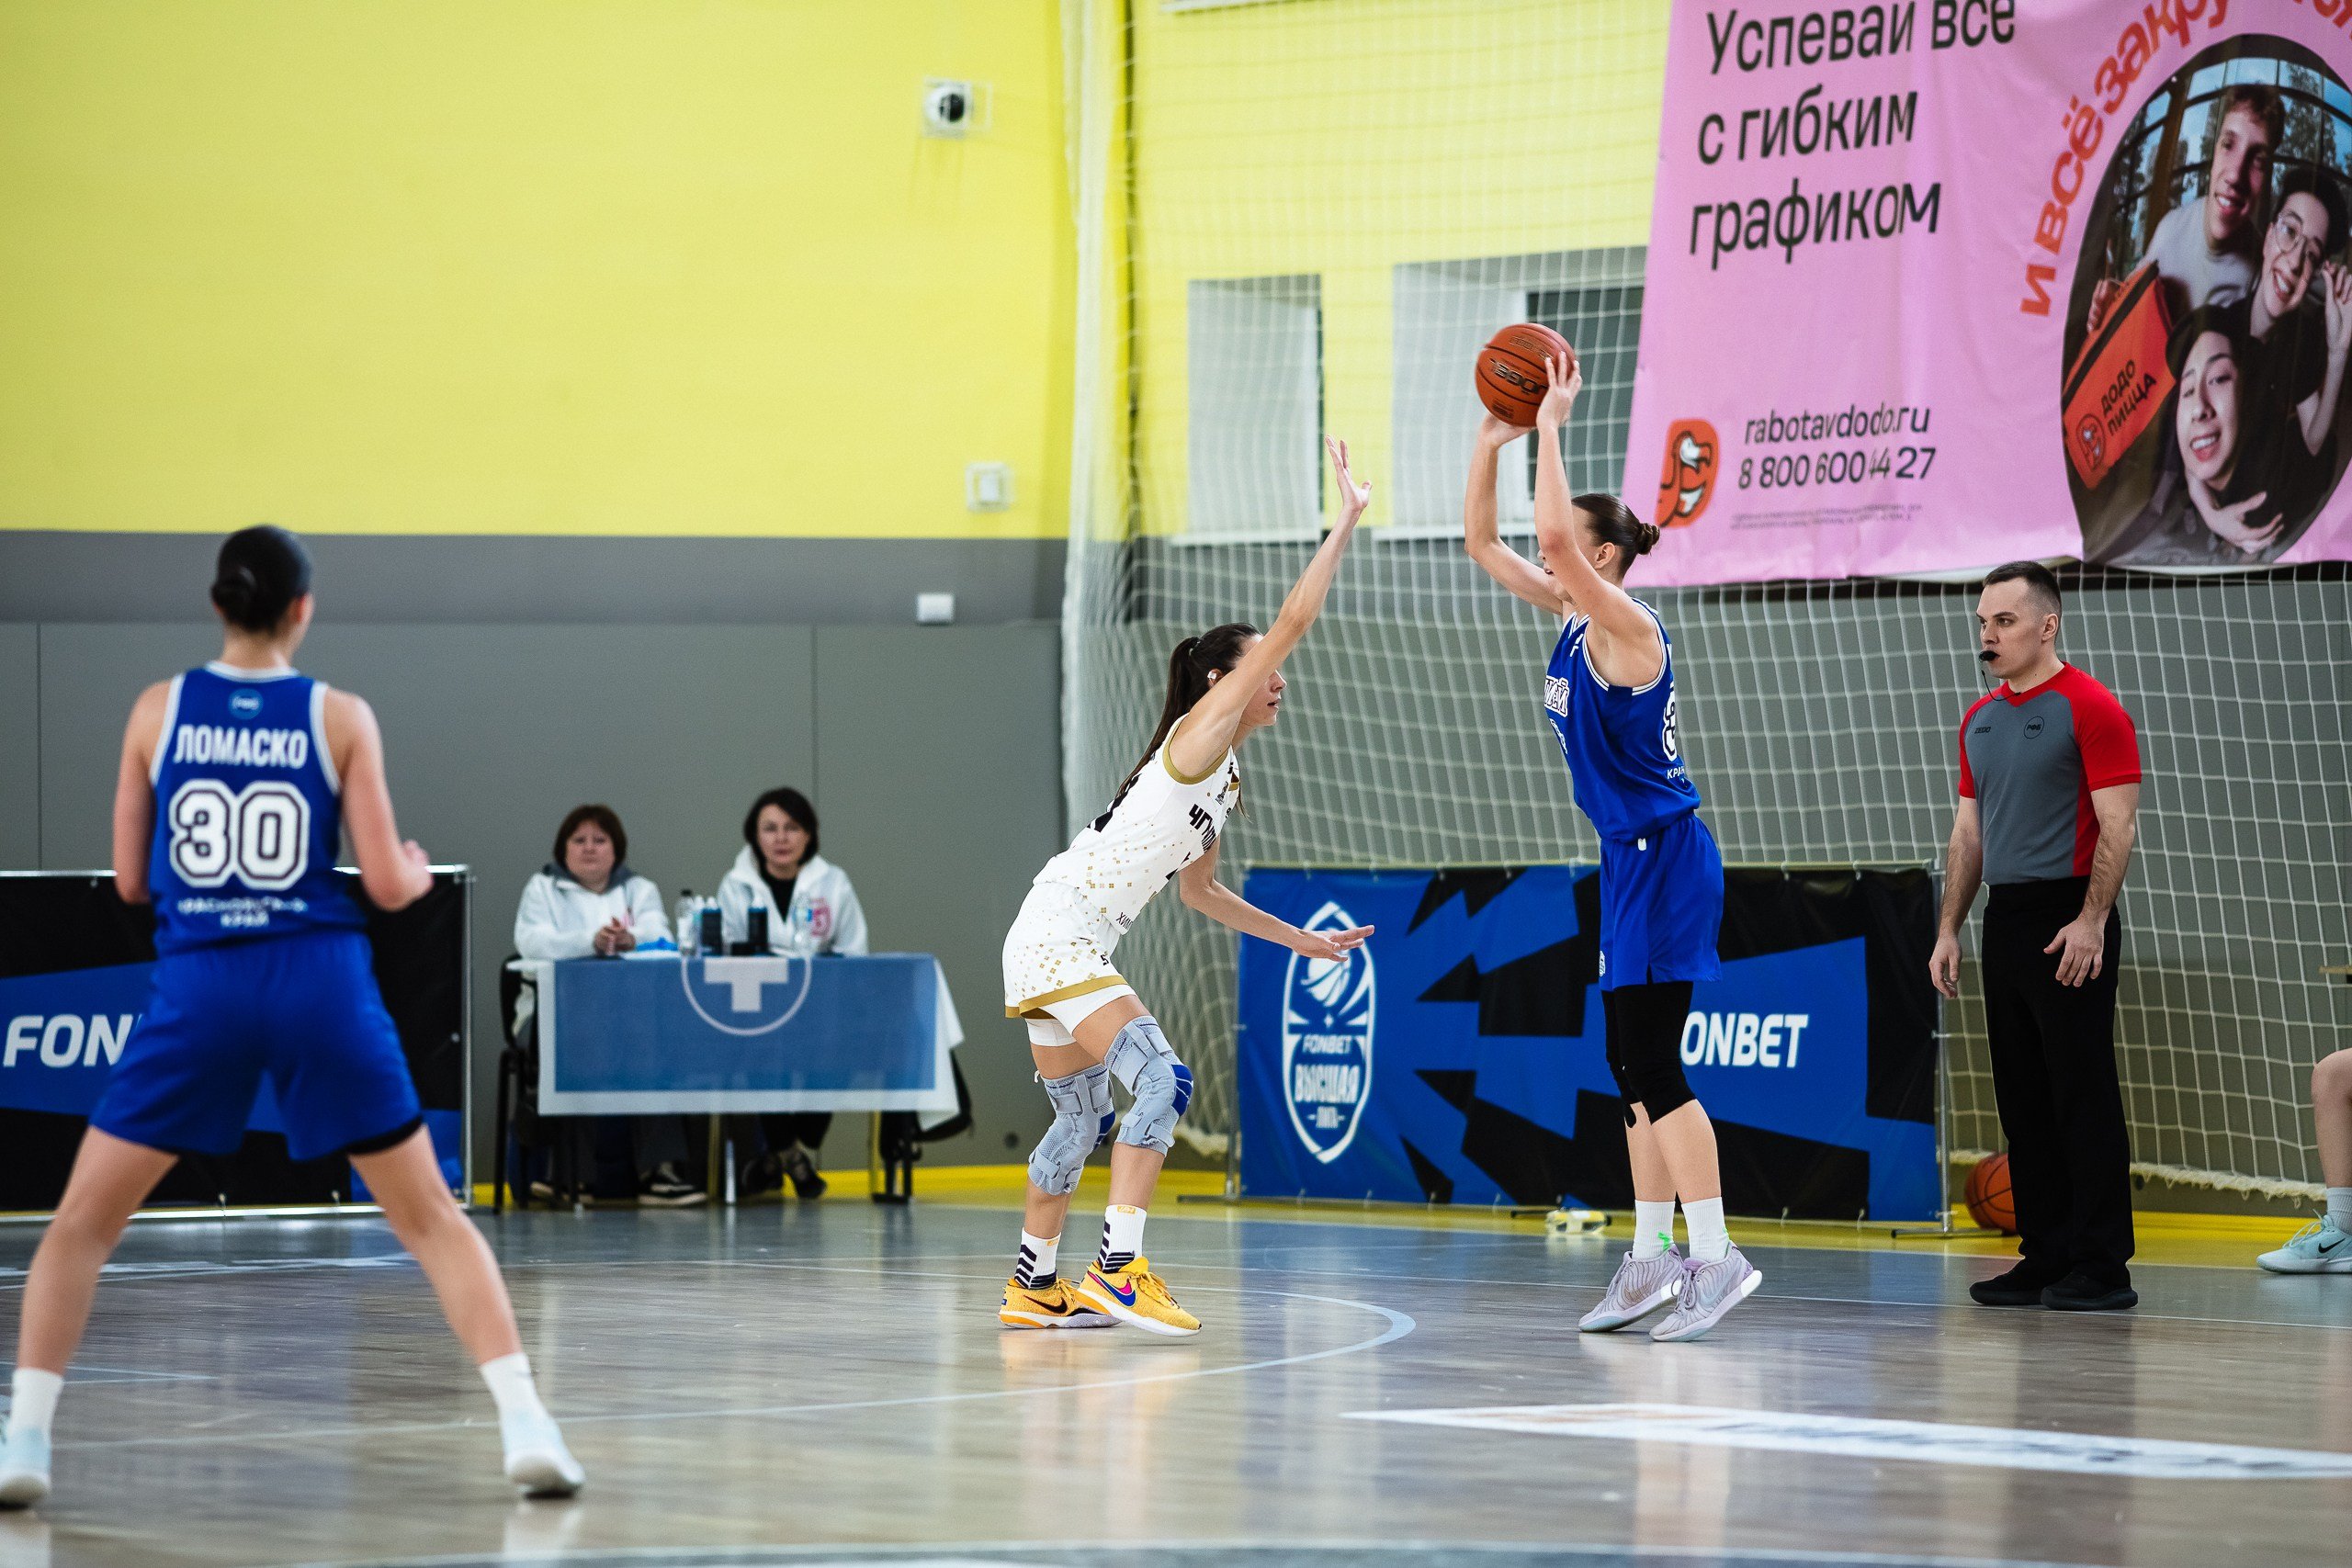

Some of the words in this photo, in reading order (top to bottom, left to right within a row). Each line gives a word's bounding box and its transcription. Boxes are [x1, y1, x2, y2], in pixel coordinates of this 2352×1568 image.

[1698, 113, 1724, 165] с
[1738, 83, 1917, 162] гибким
[2032, 94, 2104, 255] всё
[1690, 177, 1941, 271] графиком
[2019, 263, 2056, 317] и
[2100, 359, 2136, 418] ДОДО
[2107, 372, 2157, 437] ПИЦЦА
[1745, 401, 1930, 446] rabotavdodo.ru
[1738, 457, 1753, 490] 8
[1759, 455, 1811, 490] 800
[1815, 451, 1866, 485] 600
[1895, 446, 1937, 479] 27
[173, 724, 309, 769] ЛОМАСКО
[168, 778, 311, 891] 30
[3, 1013, 142, 1068] FON
[1302, 1033, 1353, 1055] FONBET
[1679, 1011, 1810, 1068] ONBET
[1294, 1063, 1361, 1104] ВЫСШАЯ
